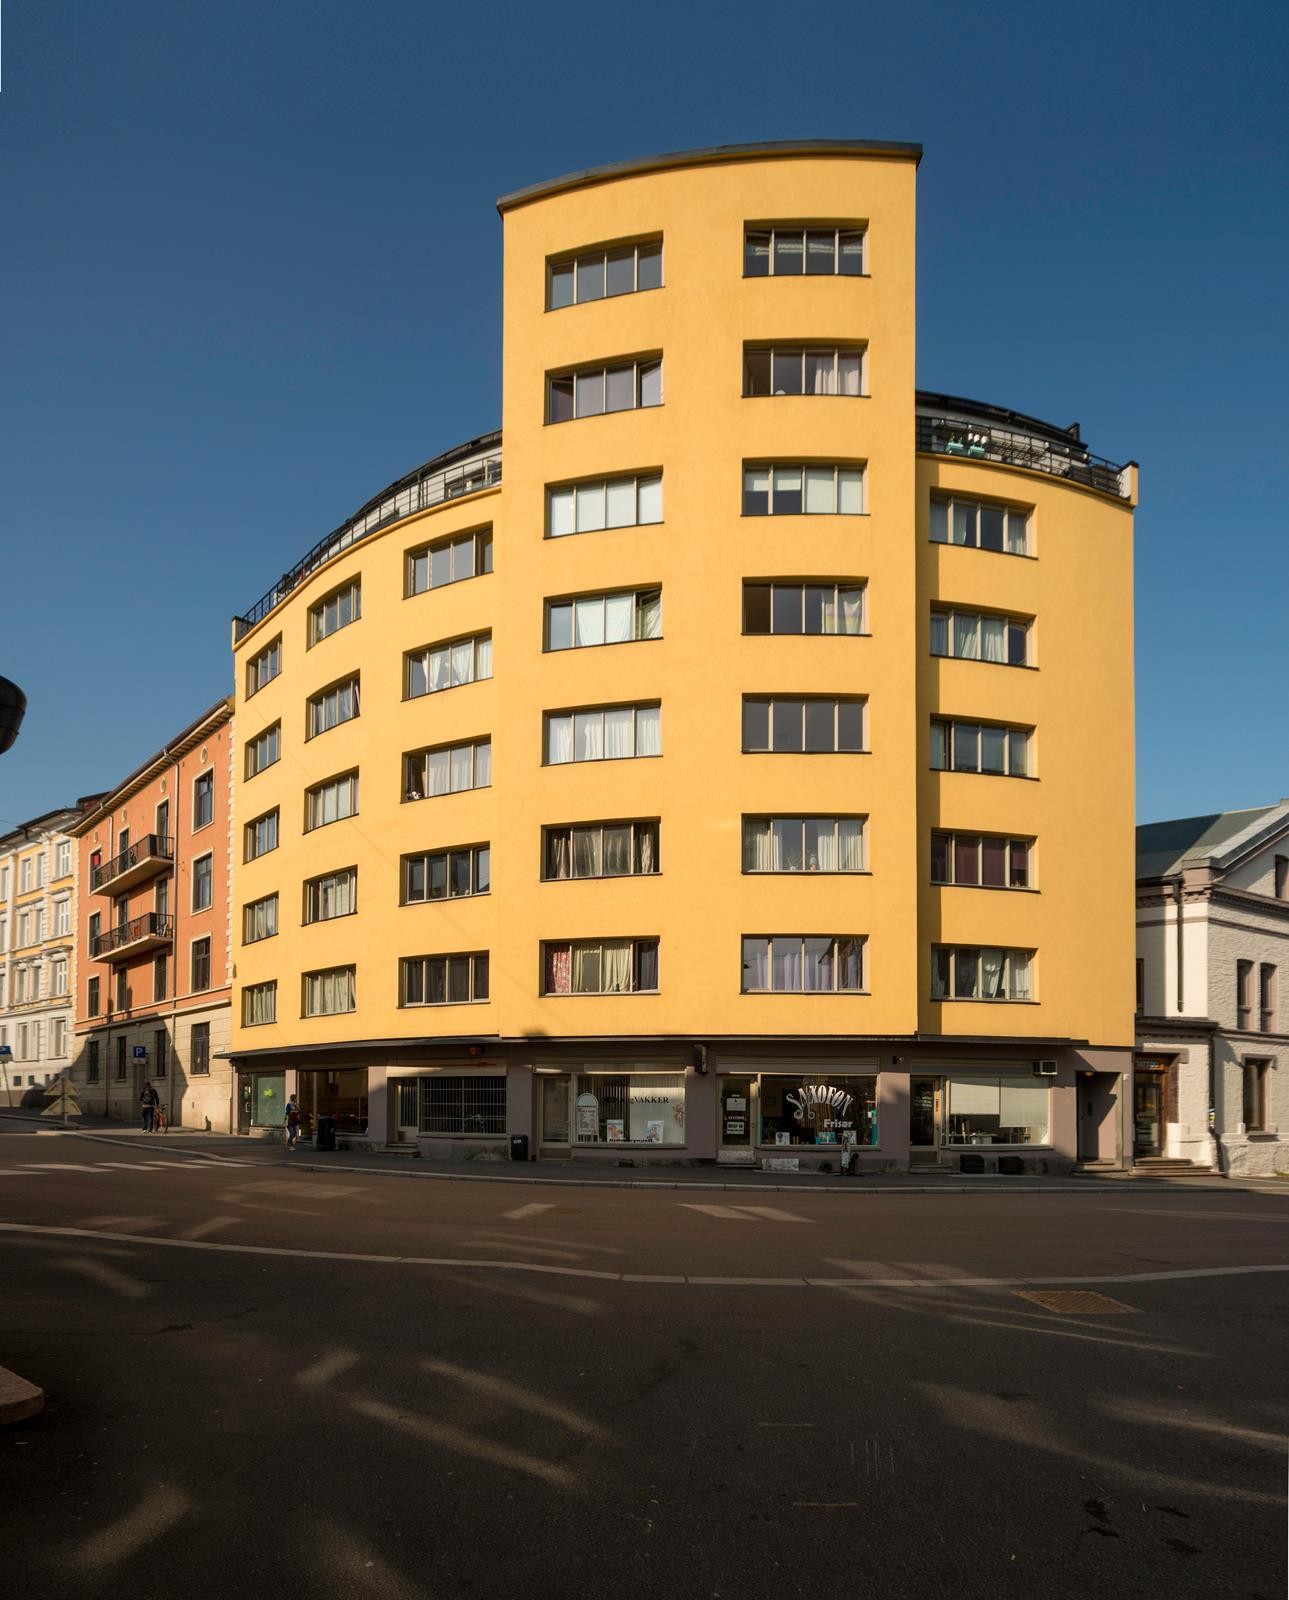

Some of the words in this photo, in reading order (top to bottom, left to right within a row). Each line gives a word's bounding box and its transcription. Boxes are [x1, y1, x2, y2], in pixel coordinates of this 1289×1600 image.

[135, 1047, 143, 1057] P
[634, 1096, 669, 1104] VAKKER
[785, 1085, 853, 1119] SAXOFON
